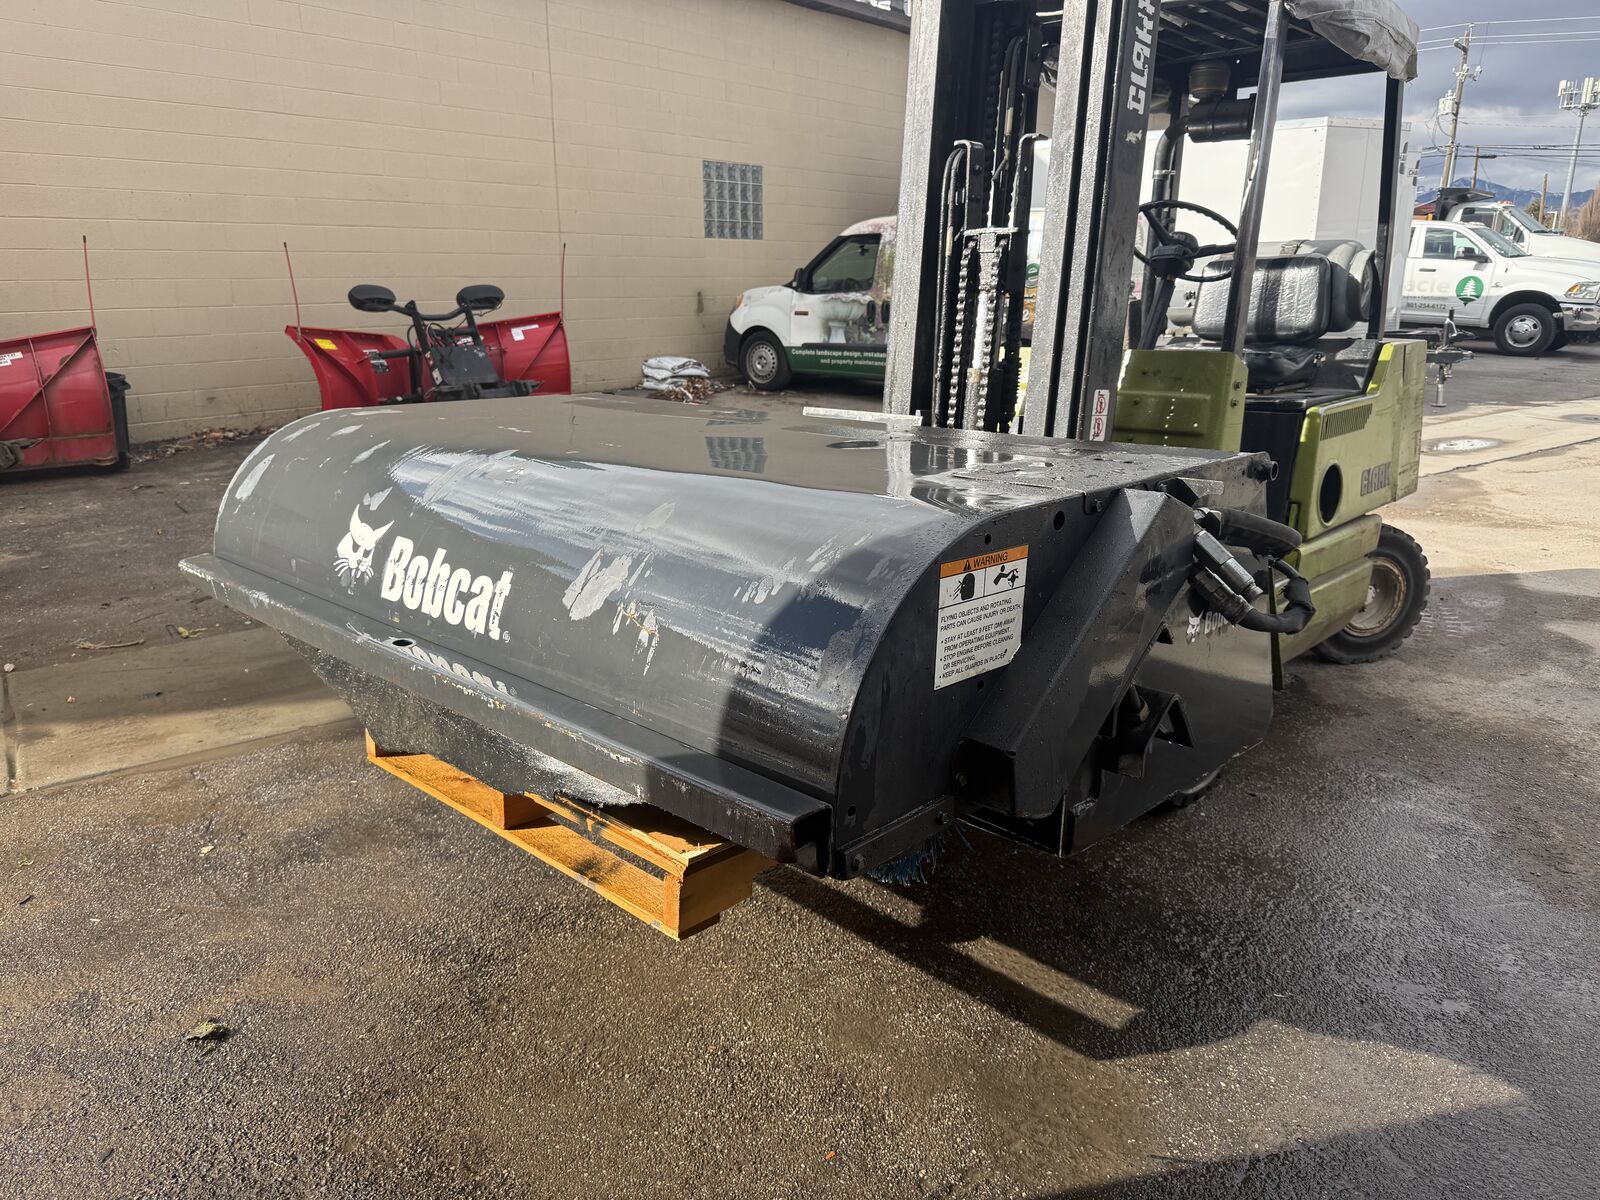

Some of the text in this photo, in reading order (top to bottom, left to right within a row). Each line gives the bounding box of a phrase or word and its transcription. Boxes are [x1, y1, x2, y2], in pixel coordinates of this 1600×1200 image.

[791, 348, 816, 356] Complete
[973, 552, 1009, 568] WARNING
[381, 536, 513, 640] Bobcat
[940, 598, 1012, 623] FLYING OBJECTS AND ROTATING
[940, 621, 955, 631] PARTS
[956, 618, 966, 627] CAN
[966, 614, 982, 624] CAUSE
[982, 609, 998, 619] INJURY
[944, 634, 956, 644] STAY
[956, 632, 963, 640] AT
[963, 628, 978, 638] LEAST
[982, 623, 993, 632] FEET
[1002, 616, 1015, 626] AWAY
[943, 642, 957, 653] FROM
[958, 634, 984, 648] OPERATING
[943, 633, 1013, 661] STOP ENGINE BEFORE CLEANING
[942, 662, 950, 670] OR
[942, 669, 954, 678] KEEP
[954, 666, 963, 674] ALL
[964, 659, 983, 671] GUARDS
